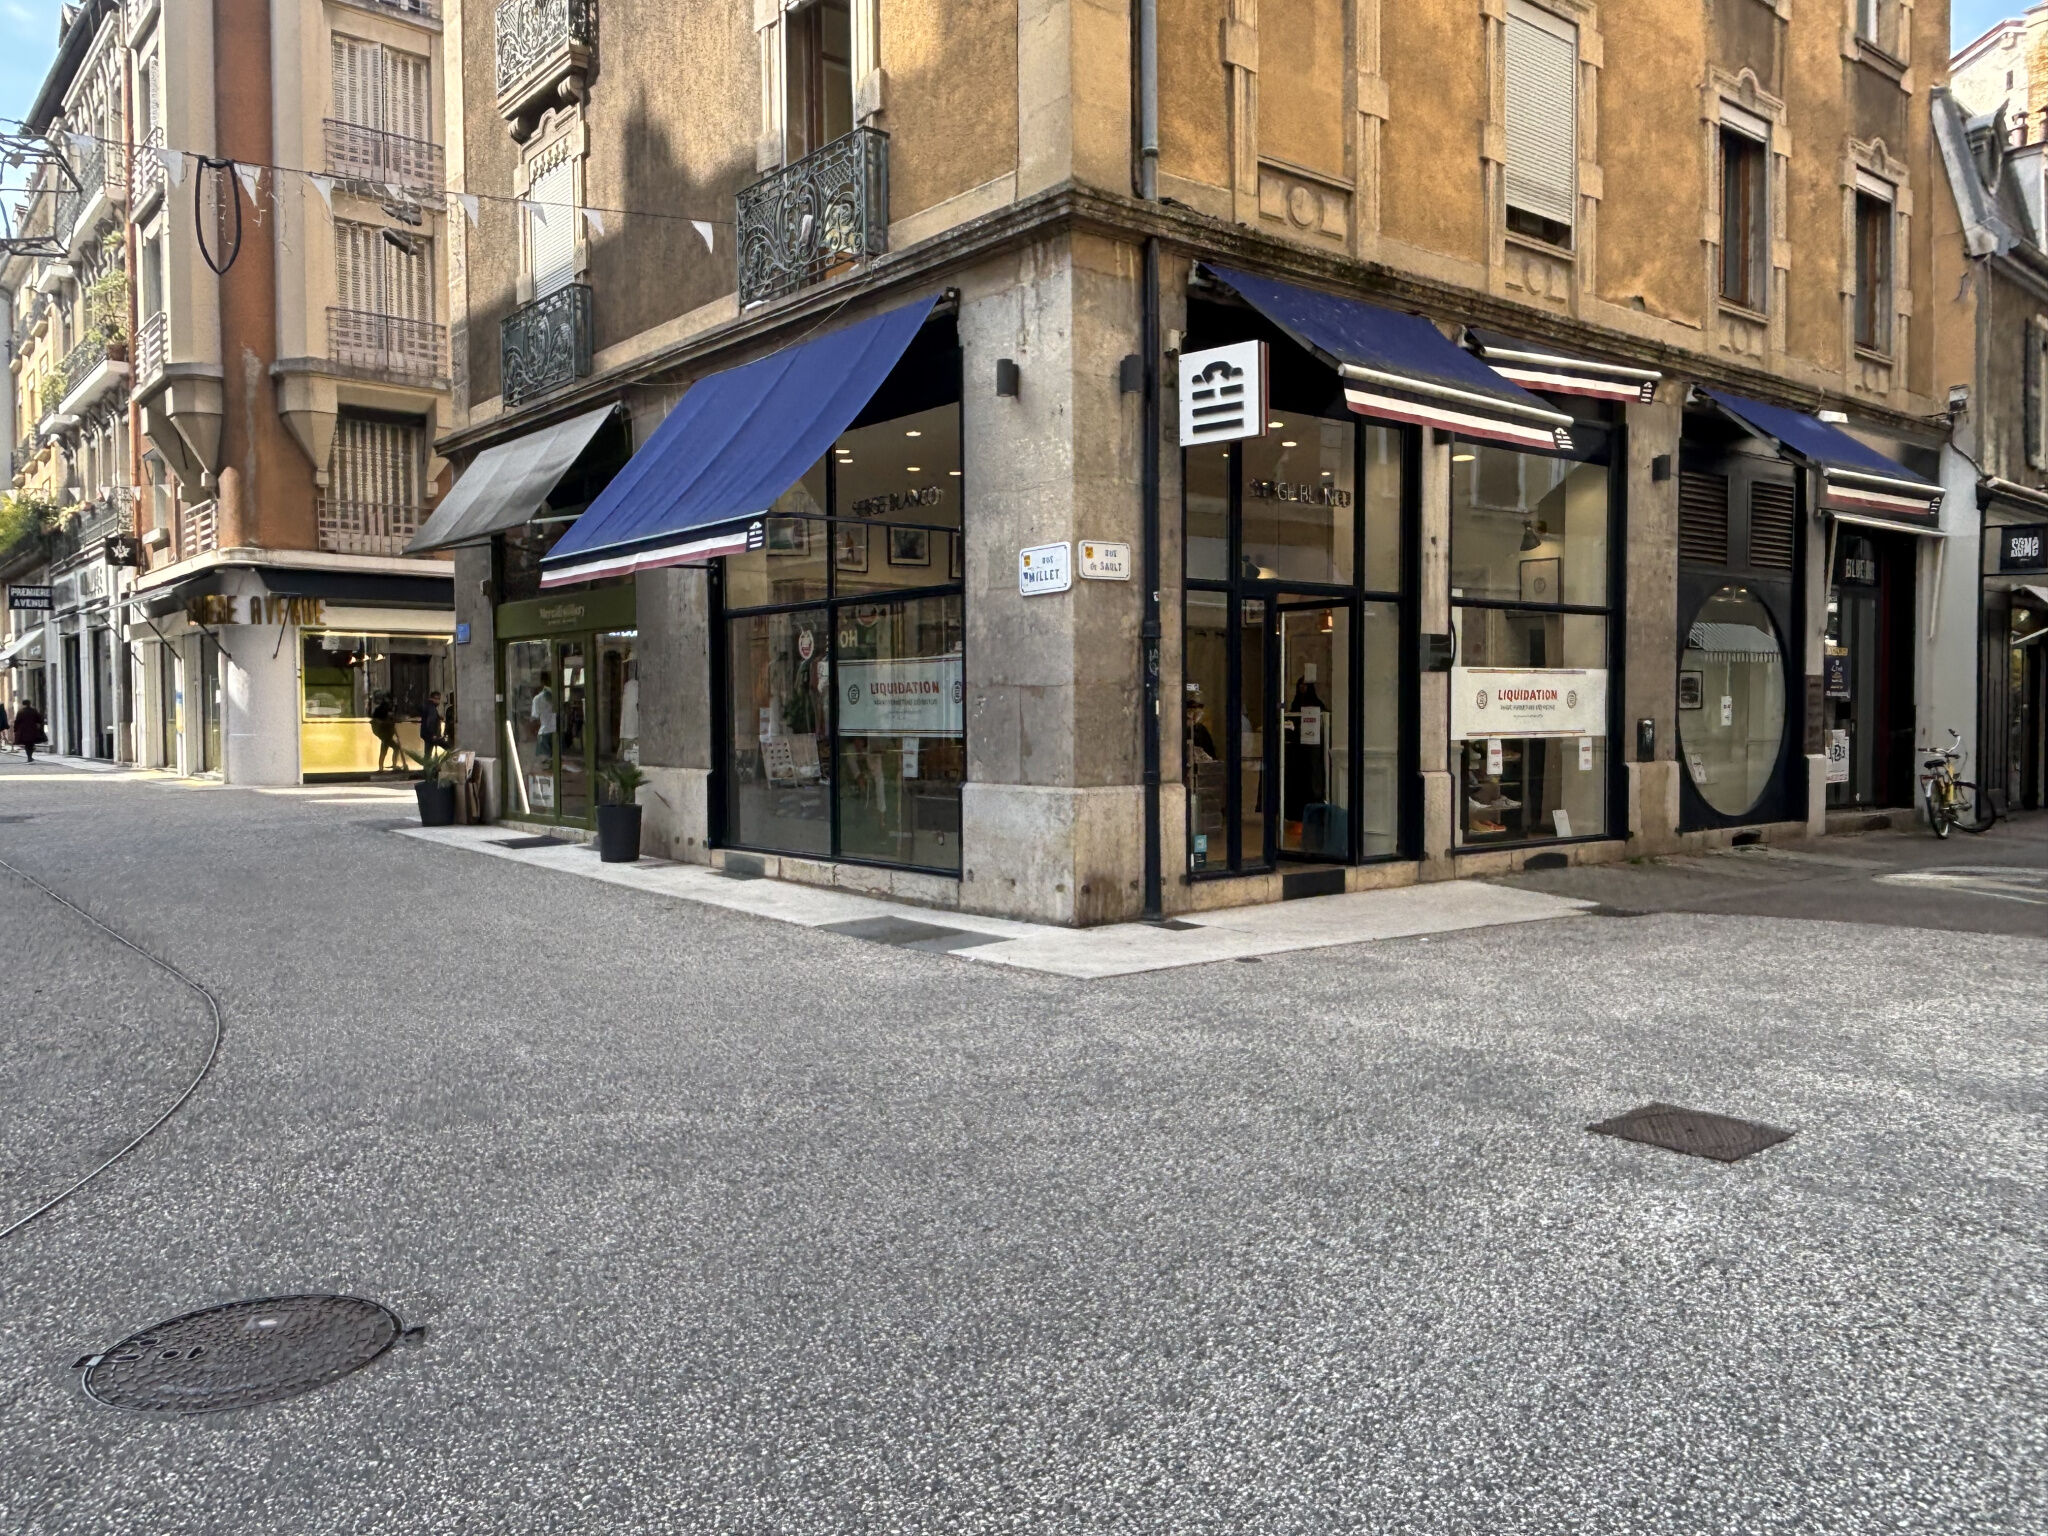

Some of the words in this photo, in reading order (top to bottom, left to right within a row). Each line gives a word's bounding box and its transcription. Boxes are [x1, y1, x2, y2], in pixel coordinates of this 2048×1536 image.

[1300, 484, 1351, 508] BLNCO
[1028, 568, 1060, 583] MILLET
[13, 598, 50, 608] AVENUE
[250, 595, 326, 626] AVENUE
[870, 681, 940, 696] LIQUIDATION
[1498, 689, 1558, 701] LIQUIDATION
